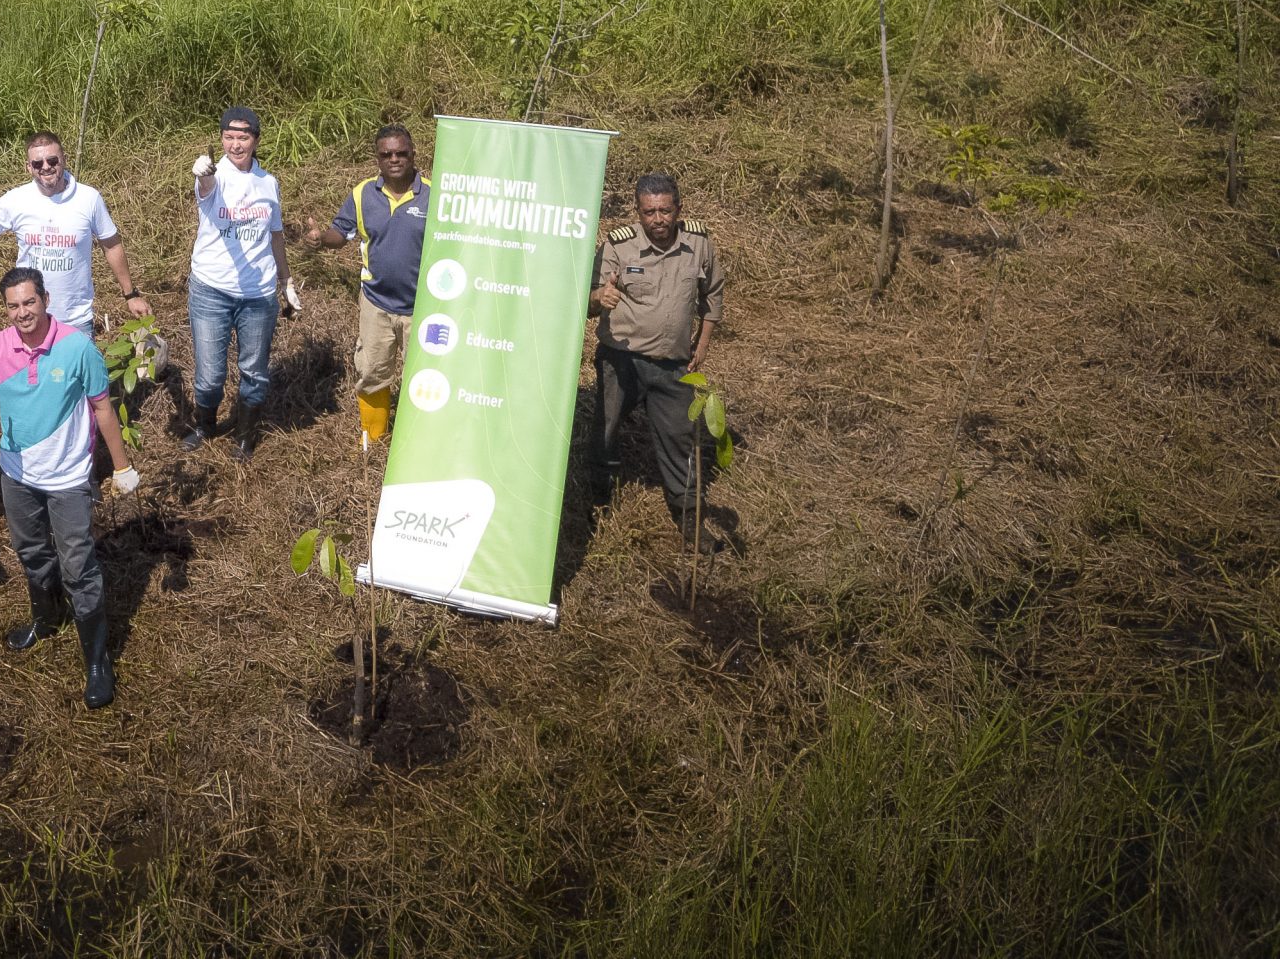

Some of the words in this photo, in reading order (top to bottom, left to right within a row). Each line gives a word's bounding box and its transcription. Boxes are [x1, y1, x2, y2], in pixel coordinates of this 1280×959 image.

[440, 172, 501, 197] GROWING
[503, 178, 537, 201] WITH
[219, 206, 238, 220] ONE
[437, 192, 588, 240] COMMUNITIES
[25, 233, 41, 246] ONE
[45, 234, 77, 248] SPARK
[433, 230, 537, 254] sparkfoundation.com.my
[42, 248, 65, 257] CHANGE
[42, 257, 73, 272] WORLD
[473, 276, 531, 297] Conserve
[465, 331, 515, 352] Educate
[457, 387, 504, 408] Partner
[384, 510, 466, 538] SPARK
[395, 532, 448, 548] FOUNDATION
